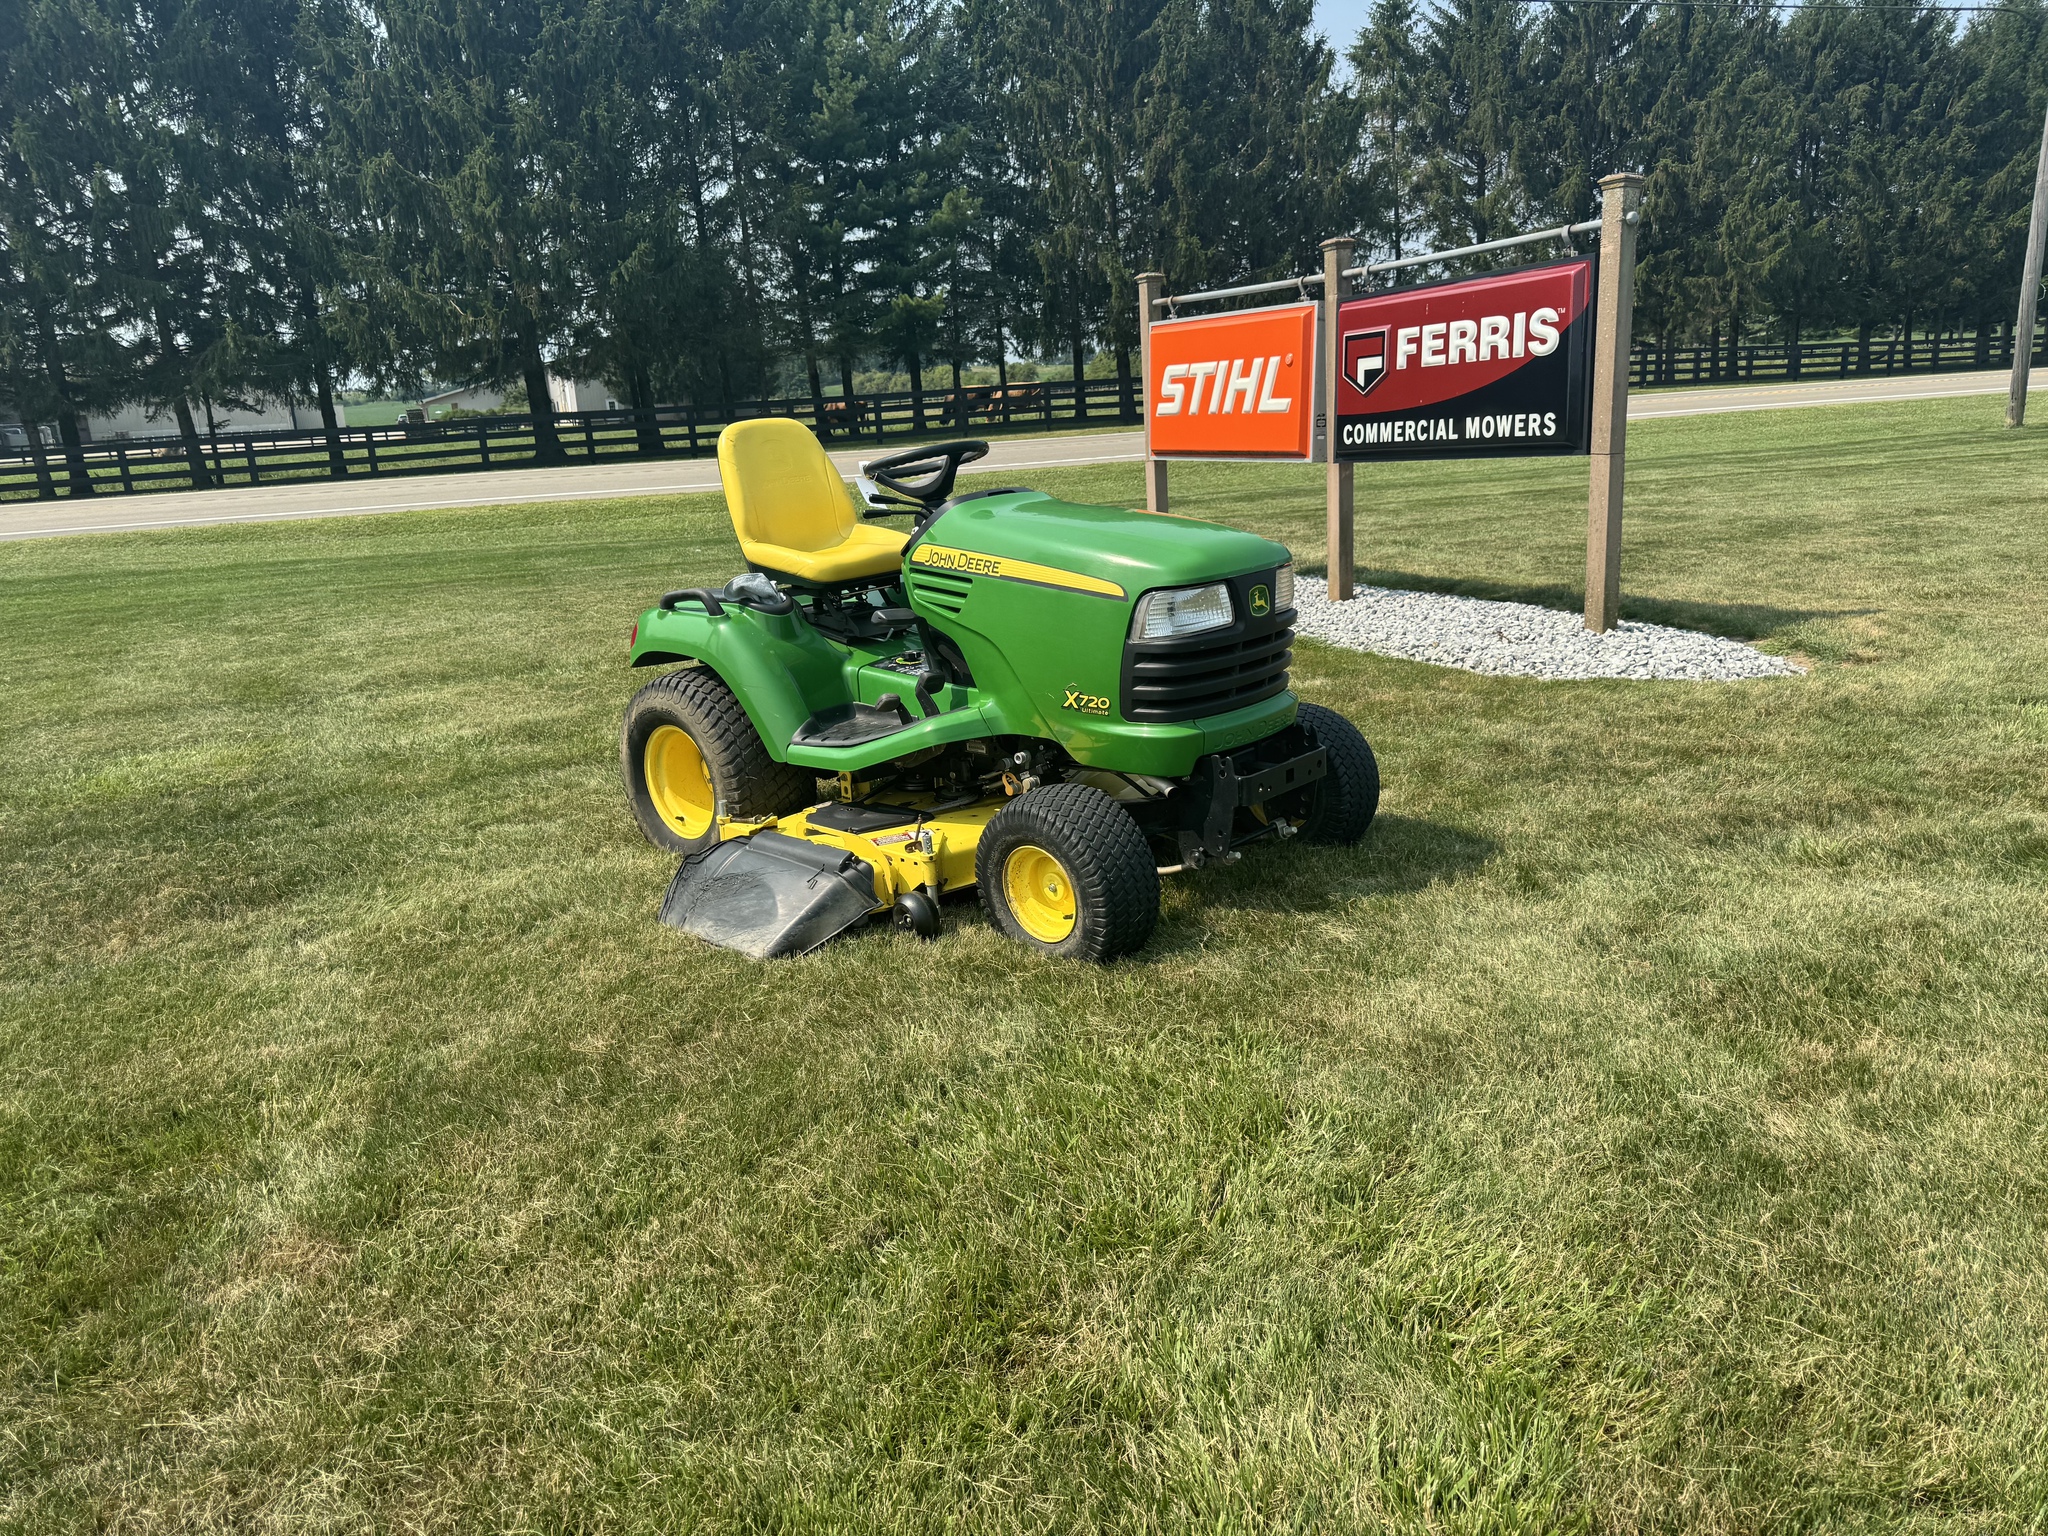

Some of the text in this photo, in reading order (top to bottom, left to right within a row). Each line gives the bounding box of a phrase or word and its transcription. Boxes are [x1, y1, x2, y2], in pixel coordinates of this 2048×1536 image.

[1396, 307, 1560, 370] FERRIS
[1156, 356, 1292, 417] STIHL
[1343, 418, 1458, 445] COMMERCIAL
[1465, 412, 1556, 438] MOWERS
[925, 549, 1001, 574] JOHN DEERE
[1063, 690, 1110, 709] X720
